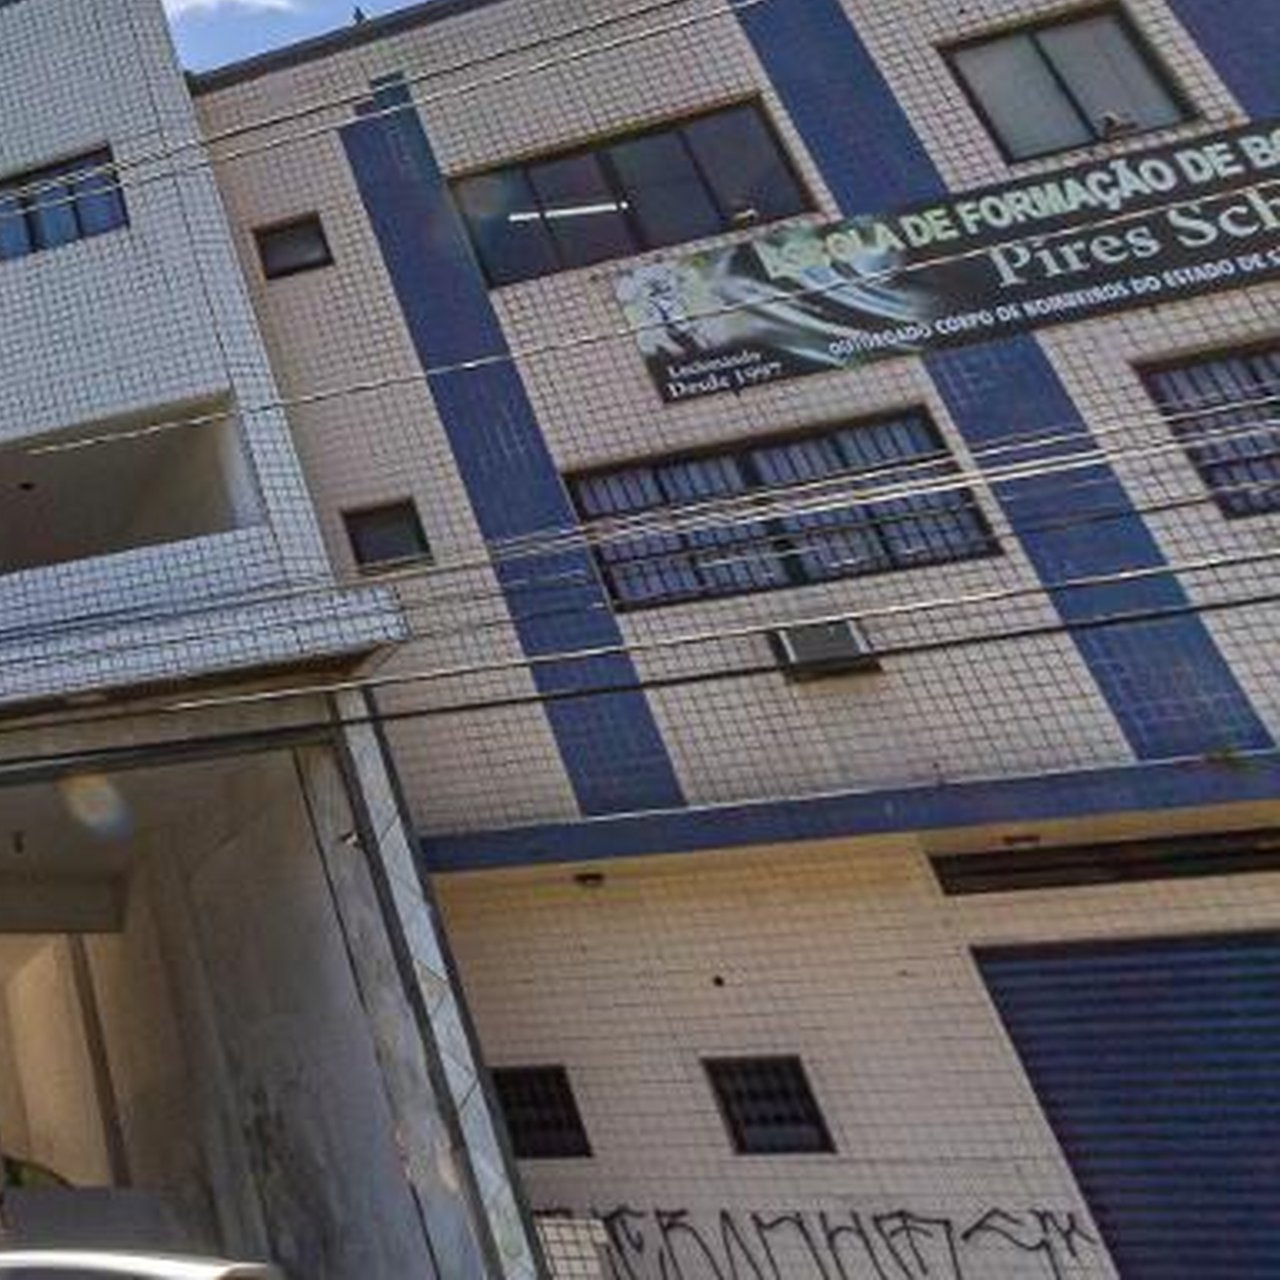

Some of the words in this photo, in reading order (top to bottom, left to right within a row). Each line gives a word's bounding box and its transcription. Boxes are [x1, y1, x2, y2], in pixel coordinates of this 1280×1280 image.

[899, 207, 961, 250] DE
[954, 158, 1178, 236] FORMAÇÃO
[1174, 142, 1246, 183] DE
[989, 226, 1162, 288] Pires
[996, 301, 1019, 322] DE
[1130, 274, 1162, 294] DO
[1162, 259, 1234, 289] ESTADO
[1236, 253, 1267, 271] DE
[666, 373, 731, 398] Desde
